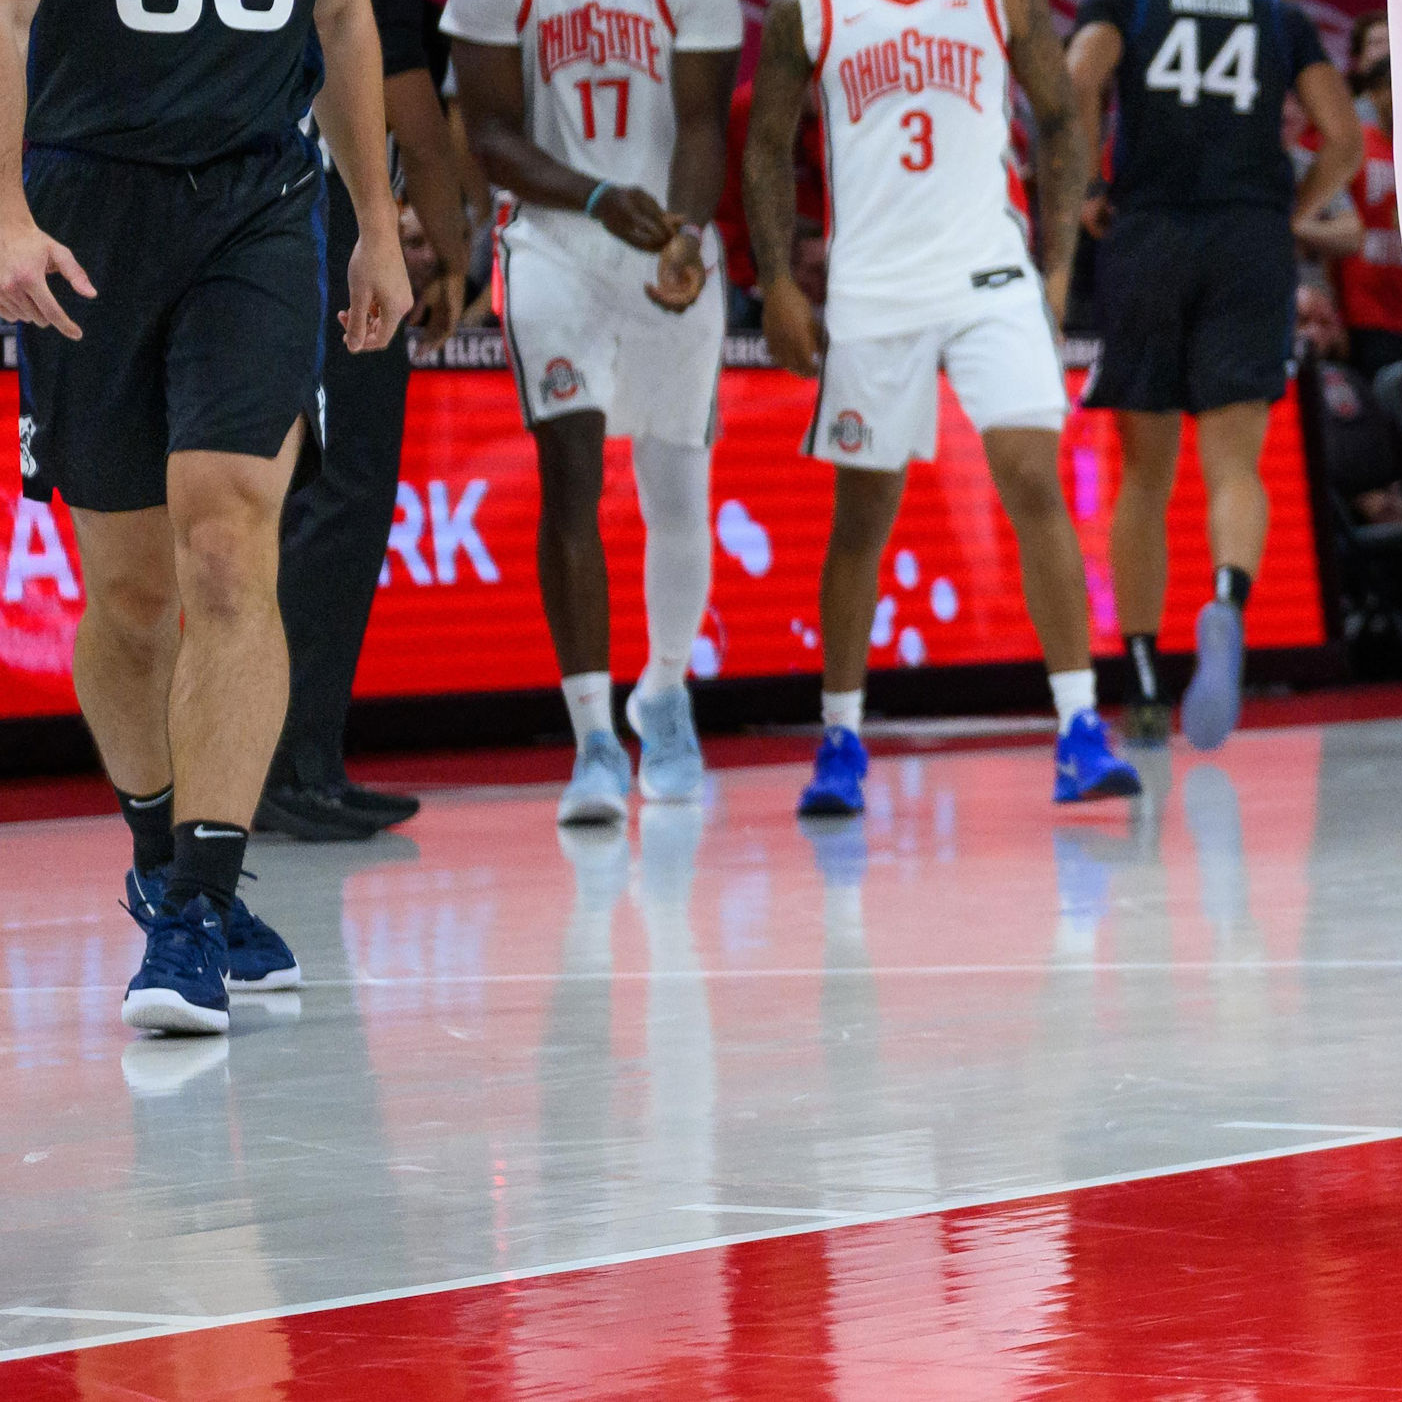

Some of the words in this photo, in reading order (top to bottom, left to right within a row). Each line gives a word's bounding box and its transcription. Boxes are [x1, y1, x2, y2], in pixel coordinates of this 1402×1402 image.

[1146, 16, 1258, 112] 44
[574, 77, 630, 140] 17
[901, 109, 934, 172] 3
